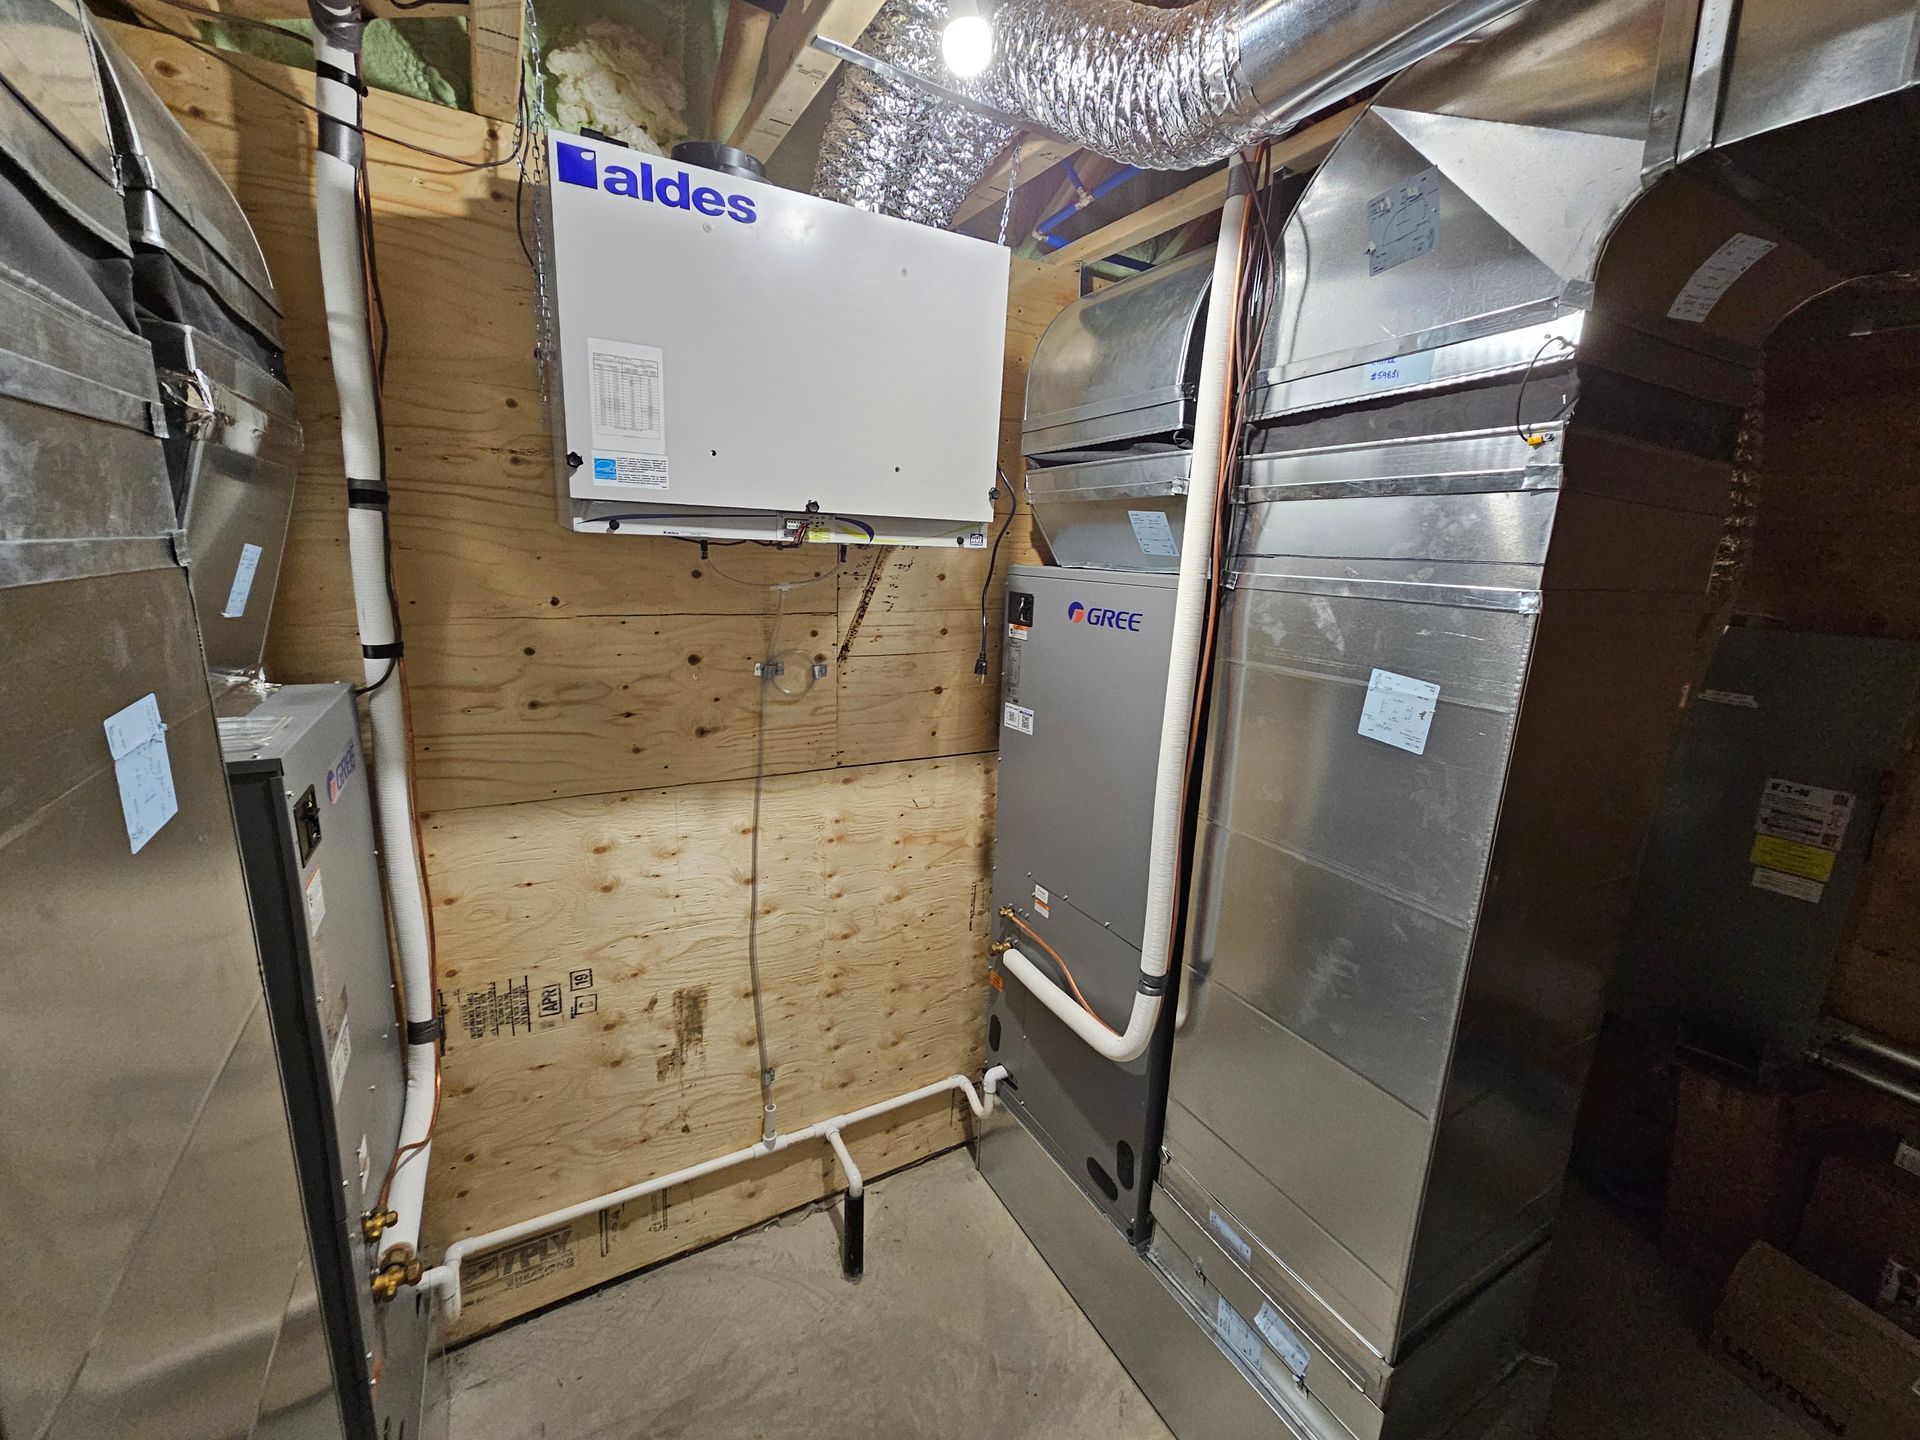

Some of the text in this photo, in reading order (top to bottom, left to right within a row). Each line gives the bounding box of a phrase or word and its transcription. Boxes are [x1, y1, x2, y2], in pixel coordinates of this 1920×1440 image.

[603, 162, 757, 224] aldes
[1086, 607, 1143, 632] GREE
[573, 973, 589, 986] 19
[541, 988, 558, 1011] APR
